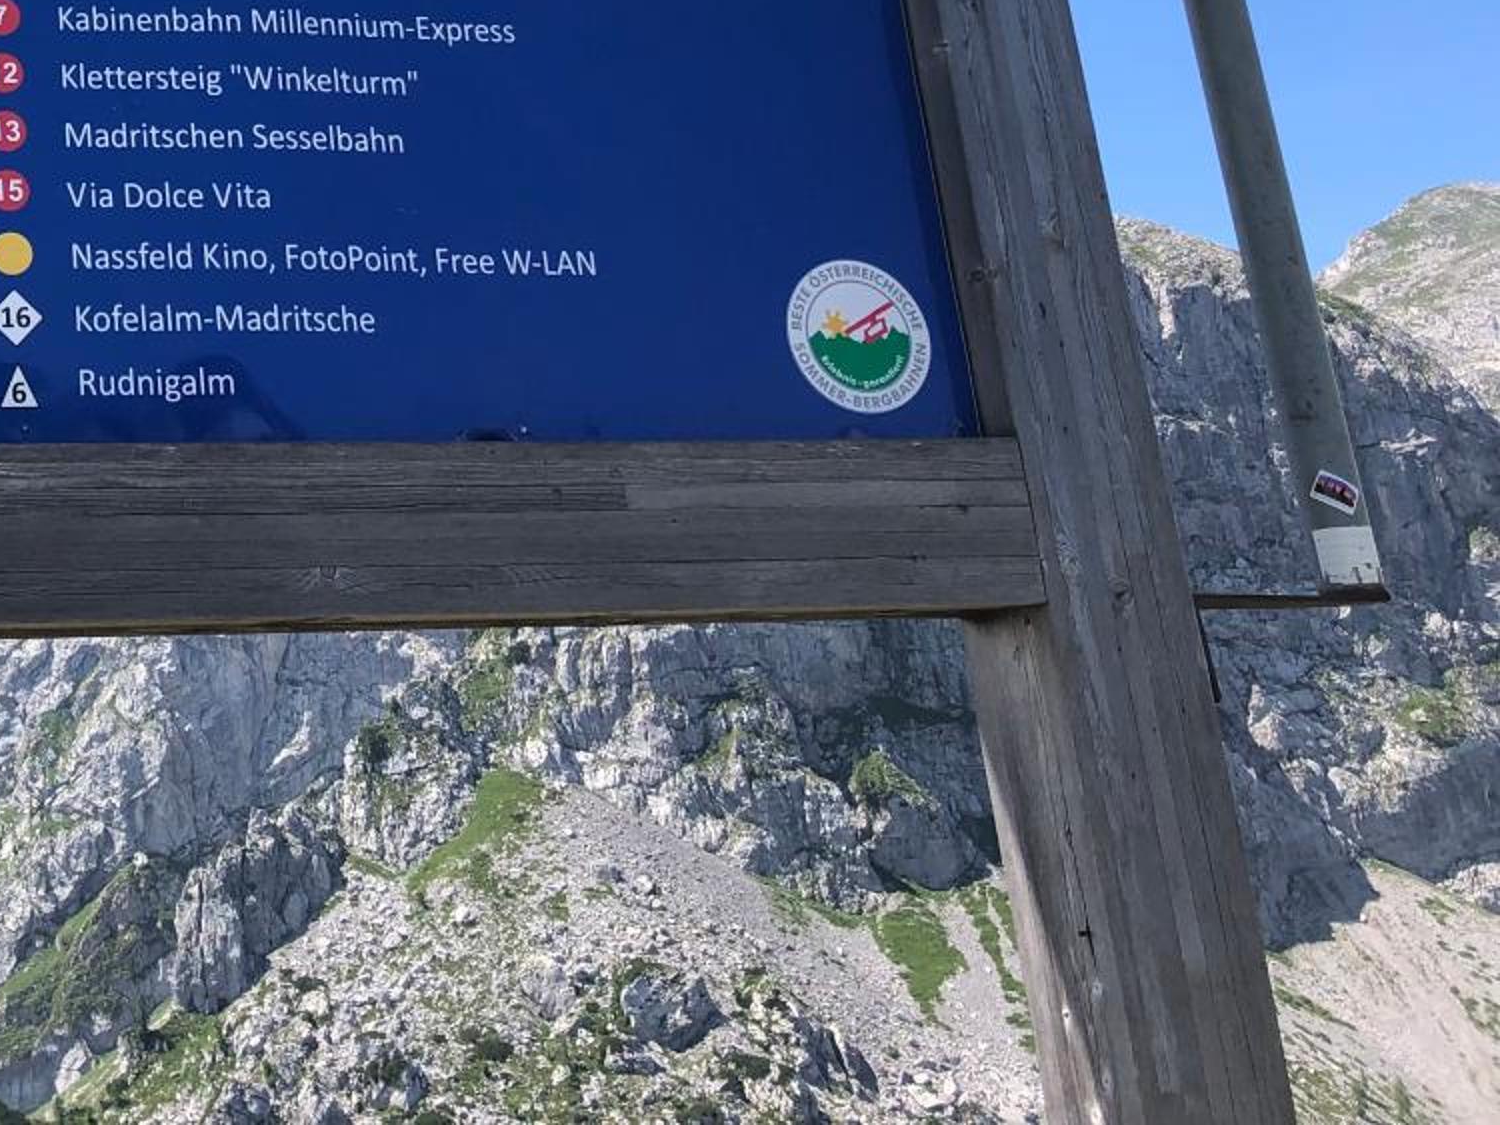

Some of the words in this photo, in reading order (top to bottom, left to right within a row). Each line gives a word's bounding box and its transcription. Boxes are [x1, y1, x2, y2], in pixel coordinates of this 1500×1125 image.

[58, 5, 242, 33] Kabinenbahn
[251, 8, 516, 47] Millennium-Express
[61, 62, 223, 96] Klettersteig
[230, 63, 418, 96] "Winkelturm"
[65, 122, 244, 149] Madritschen
[252, 123, 405, 153] Sesselbahn
[66, 182, 114, 208] Via
[123, 181, 204, 209] Dolce
[211, 182, 271, 209] Vita
[71, 241, 193, 270] Nassfeld
[203, 242, 276, 274] Kino,
[285, 243, 427, 278] FotoPoint,
[435, 247, 495, 275] Free
[501, 249, 597, 276] W-LAN
[1, 306, 31, 328] 16
[75, 303, 375, 334] Kofelalm-Madritsche
[791, 287, 811, 331] BESTE
[12, 382, 27, 403] 6
[79, 366, 235, 403] Rudnigalm
